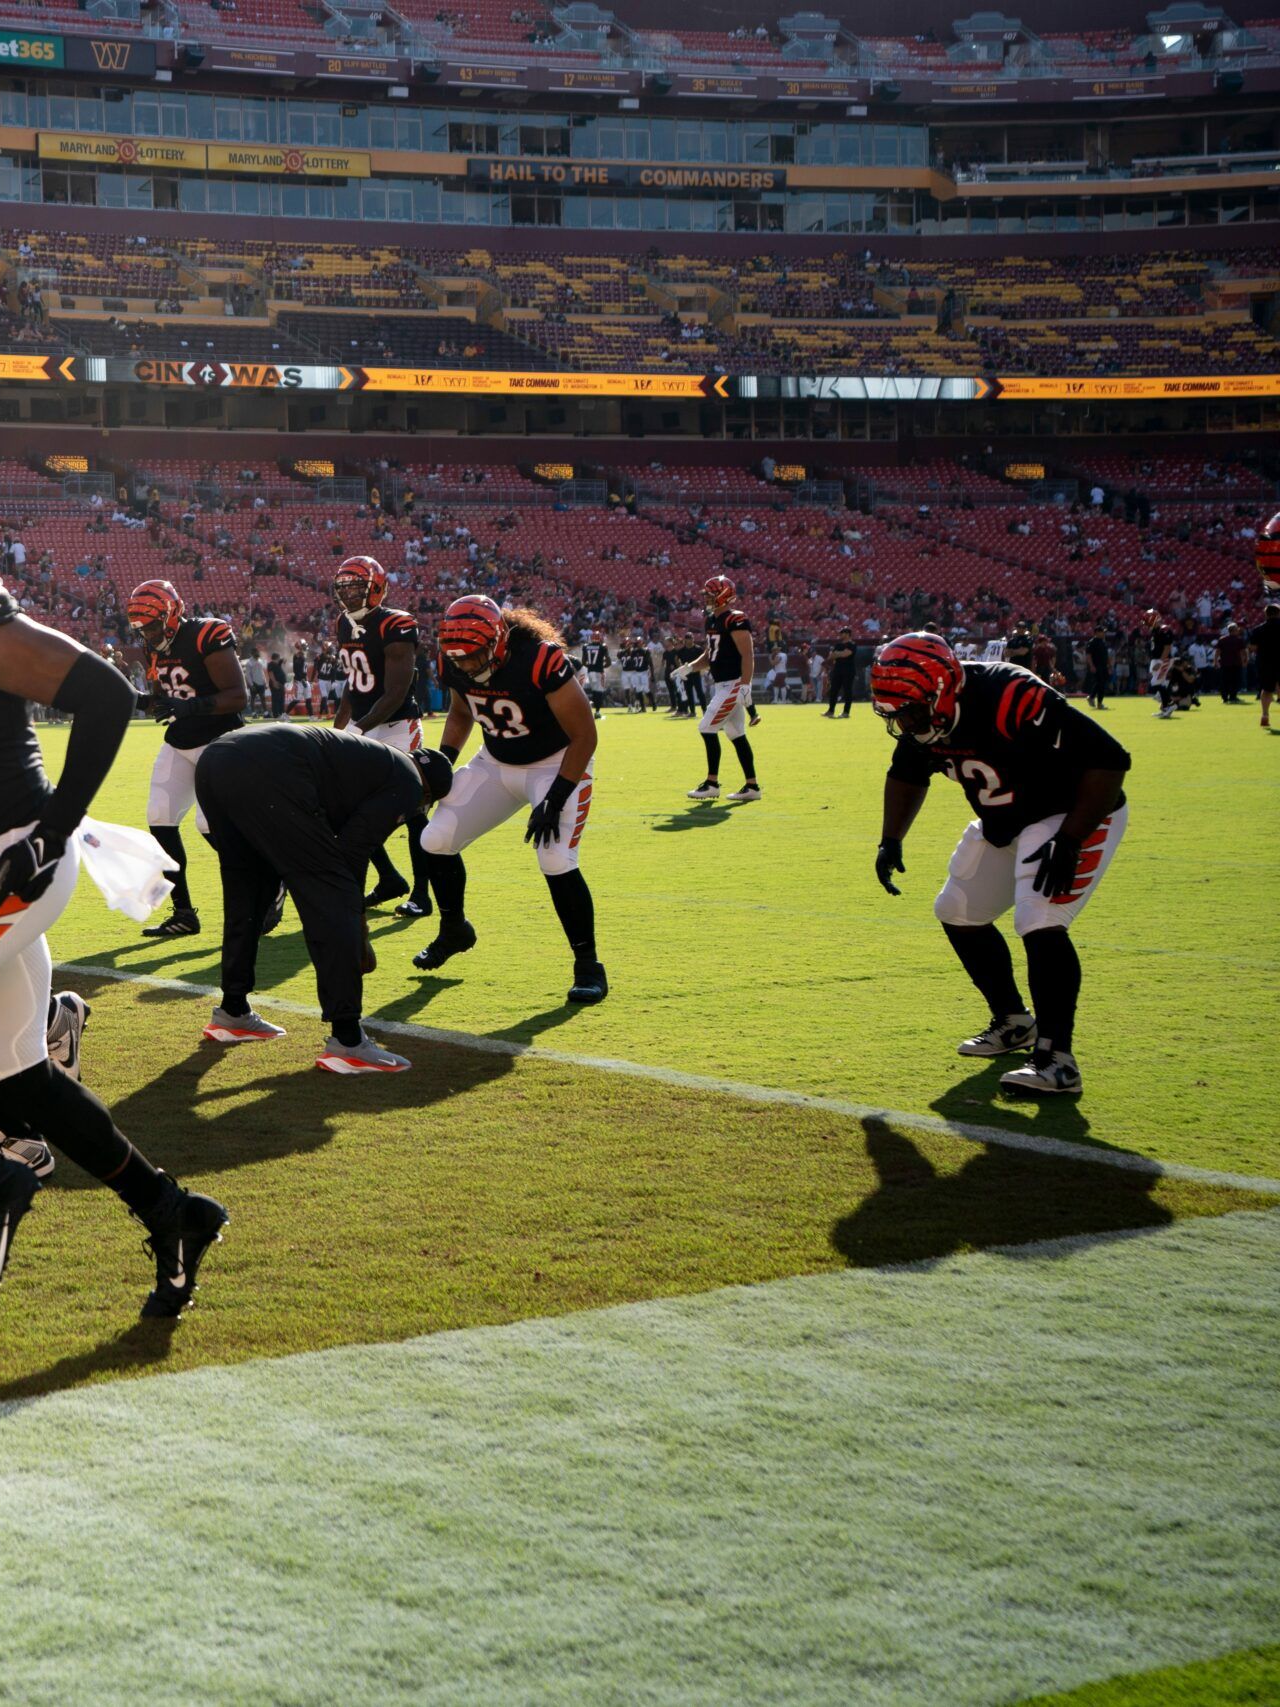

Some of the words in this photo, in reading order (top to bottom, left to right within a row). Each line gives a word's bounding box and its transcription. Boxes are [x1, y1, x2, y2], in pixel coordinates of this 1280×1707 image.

[328, 60, 342, 72] 20
[460, 67, 473, 80] 43
[563, 74, 575, 86] 17
[693, 79, 705, 91] 35
[787, 82, 800, 94] 30
[1092, 83, 1104, 95] 41
[60, 142, 116, 156] MARYLAND
[140, 149, 185, 160] LOTTERY
[228, 152, 283, 166] MARYLAND
[306, 158, 349, 169] LOTTERY
[489, 163, 535, 181] HAIL
[541, 166, 566, 181] TO
[571, 166, 609, 184] THE
[640, 169, 774, 188] COMMANDERS
[134, 361, 184, 382] CIN
[229, 364, 303, 387] WAS
[509, 378, 525, 387] TAKE
[526, 378, 560, 388] COMMAND
[1163, 383, 1181, 392] TAKE
[1182, 382, 1220, 392] COMMAND
[587, 650, 599, 665] 17
[339, 648, 375, 693] 90
[156, 666, 196, 700] 56
[466, 693, 530, 740] 53
